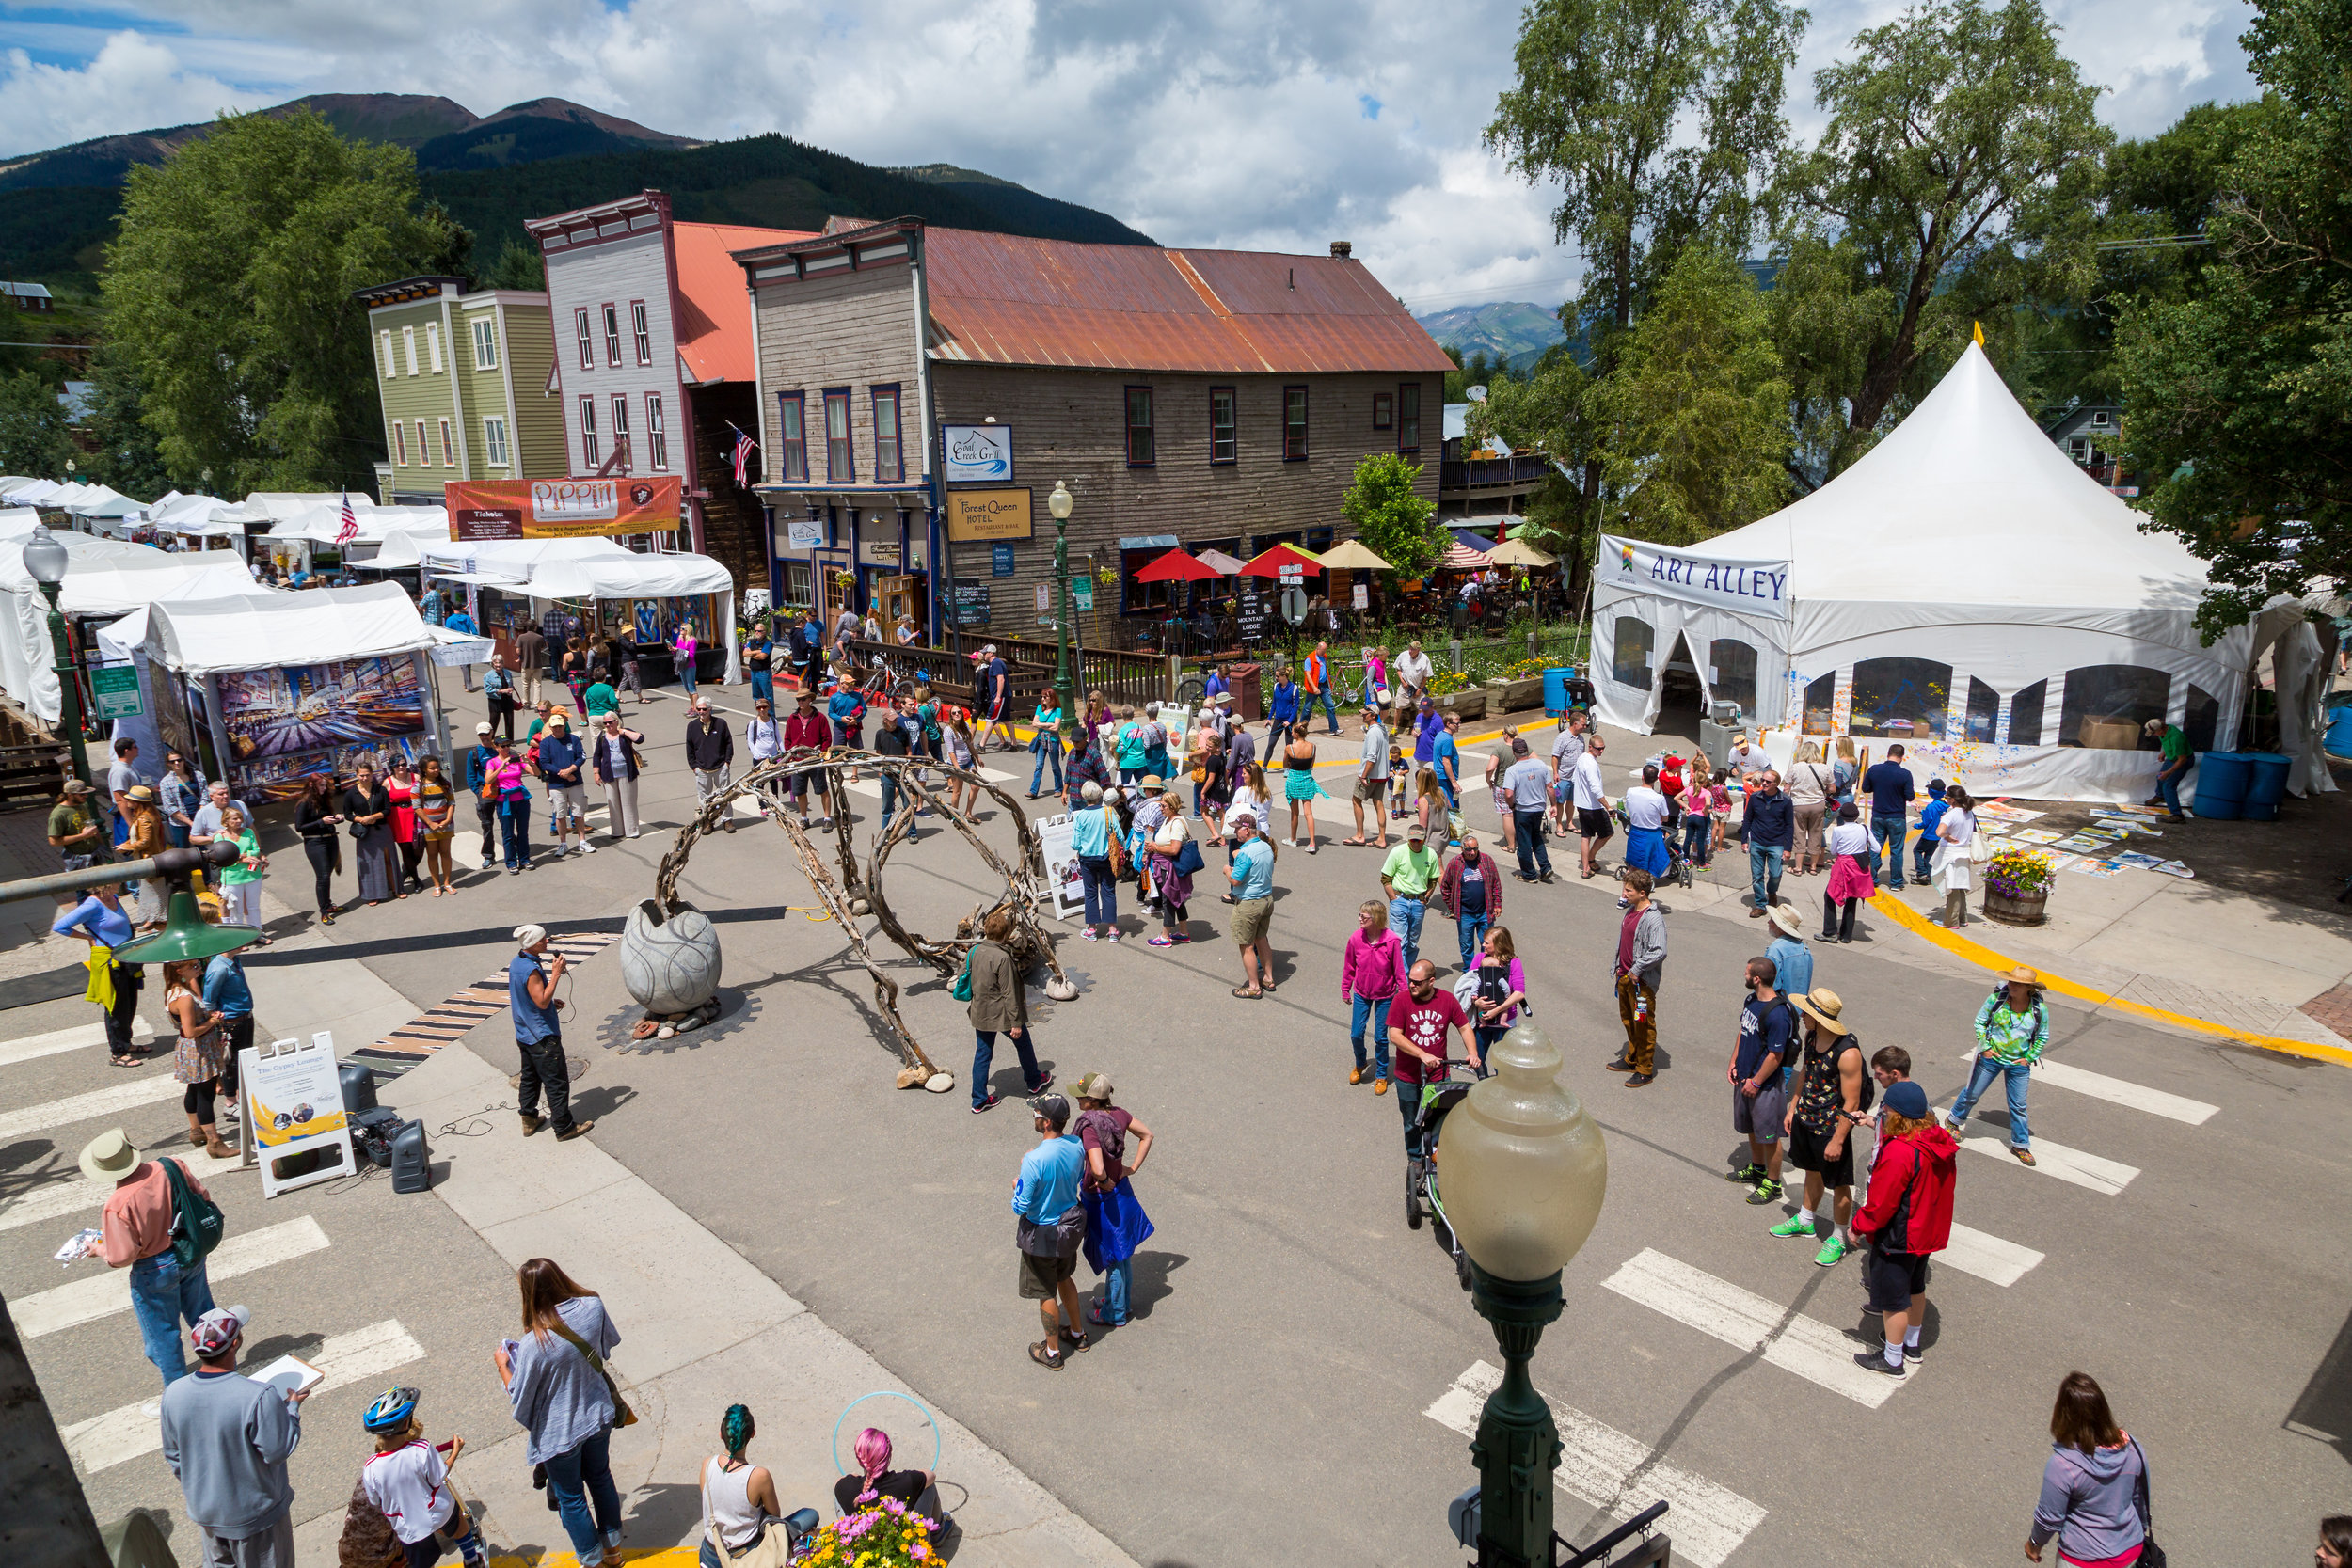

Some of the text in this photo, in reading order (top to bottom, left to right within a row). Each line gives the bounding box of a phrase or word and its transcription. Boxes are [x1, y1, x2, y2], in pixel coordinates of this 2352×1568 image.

[953, 441, 976, 453] Coal
[955, 447, 1001, 460] Creek Grill
[961, 500, 1018, 515] Forest Queen
[967, 515, 993, 525] HOTEL
[1652, 555, 1787, 600] ART ALLEY
[1411, 1010, 1443, 1022] BANFF
[1411, 1033, 1440, 1046] ROOTS
[297, 1056, 323, 1066] Lounge
